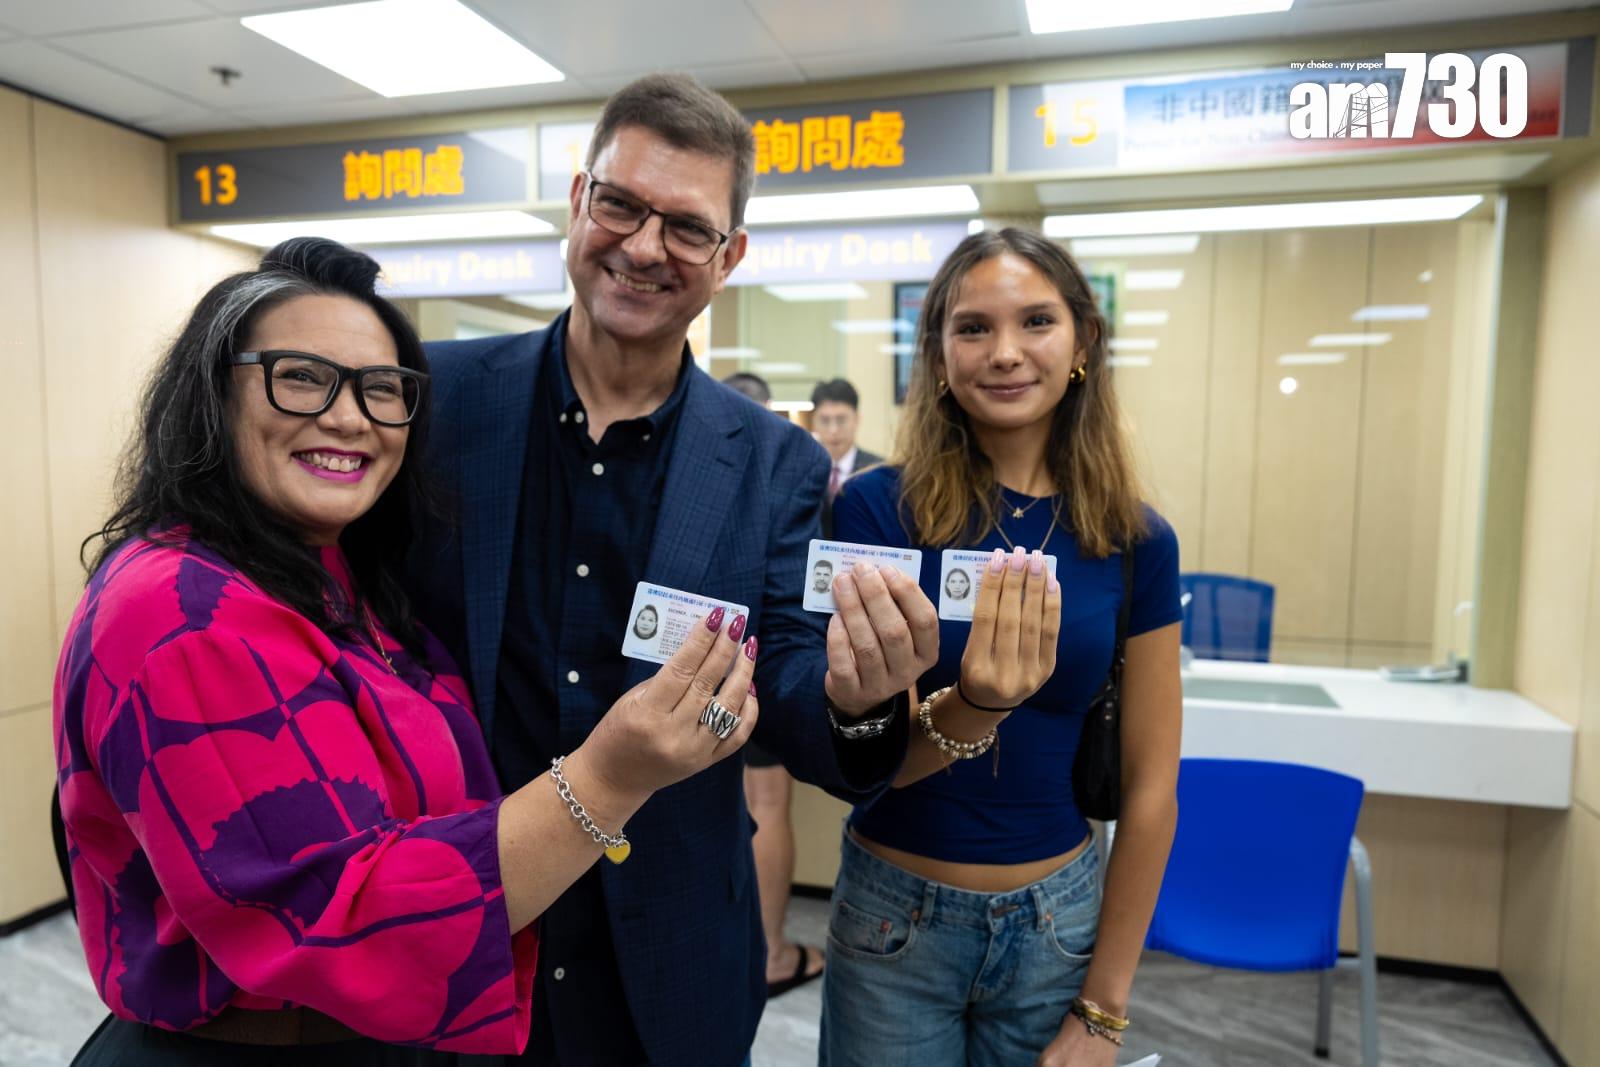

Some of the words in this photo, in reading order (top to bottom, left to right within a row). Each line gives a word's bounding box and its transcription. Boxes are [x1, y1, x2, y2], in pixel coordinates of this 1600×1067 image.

[752, 110, 904, 174] 詢問處
[1035, 99, 1097, 147] 15
[194, 164, 238, 206] 13
[343, 144, 465, 201] 詢問處
[380, 255, 450, 286] quiry
[458, 250, 534, 281] Desk
[747, 236, 831, 275] quiry
[842, 231, 932, 265] Desk
